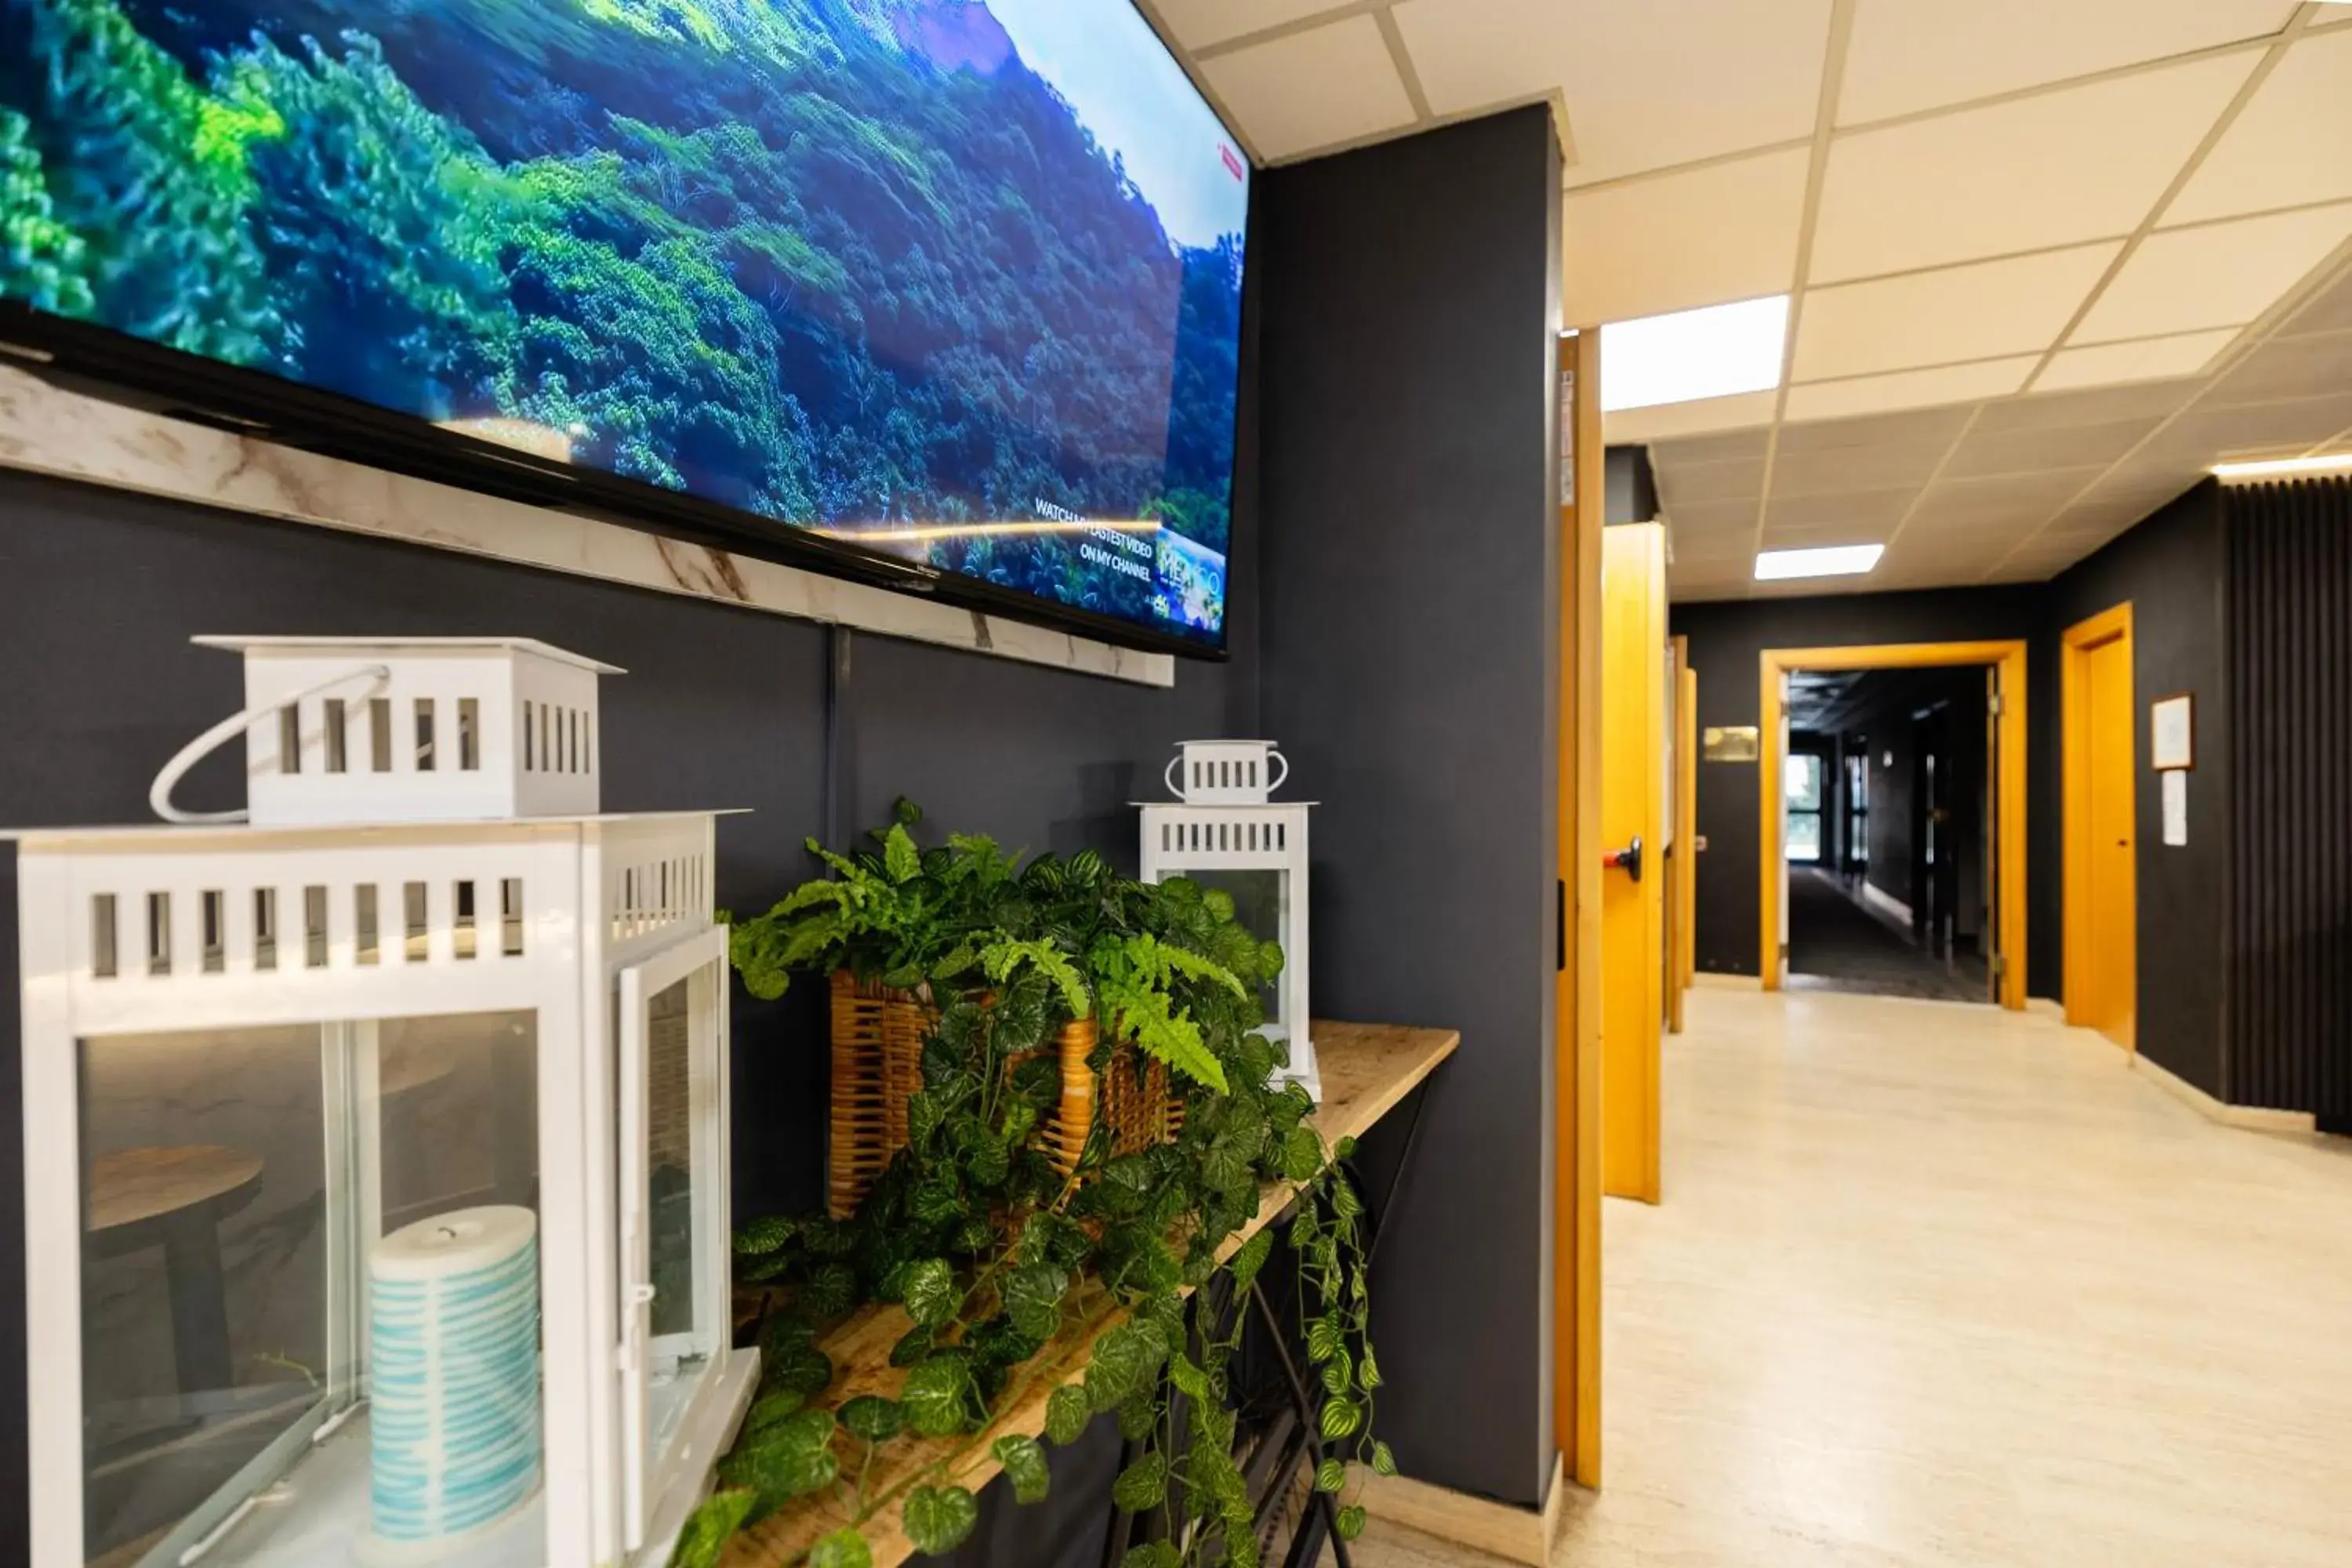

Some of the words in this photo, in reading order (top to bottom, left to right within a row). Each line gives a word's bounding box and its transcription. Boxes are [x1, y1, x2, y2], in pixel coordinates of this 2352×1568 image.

[1035, 497, 1073, 524] WATCH
[1091, 524, 1127, 546] LASTEST
[1126, 535, 1152, 559] VIDEO
[1080, 543, 1097, 561] ON
[1097, 548, 1112, 567] MY
[1111, 555, 1152, 583] CHANNEL
[1160, 550, 1221, 595] MEXCO
